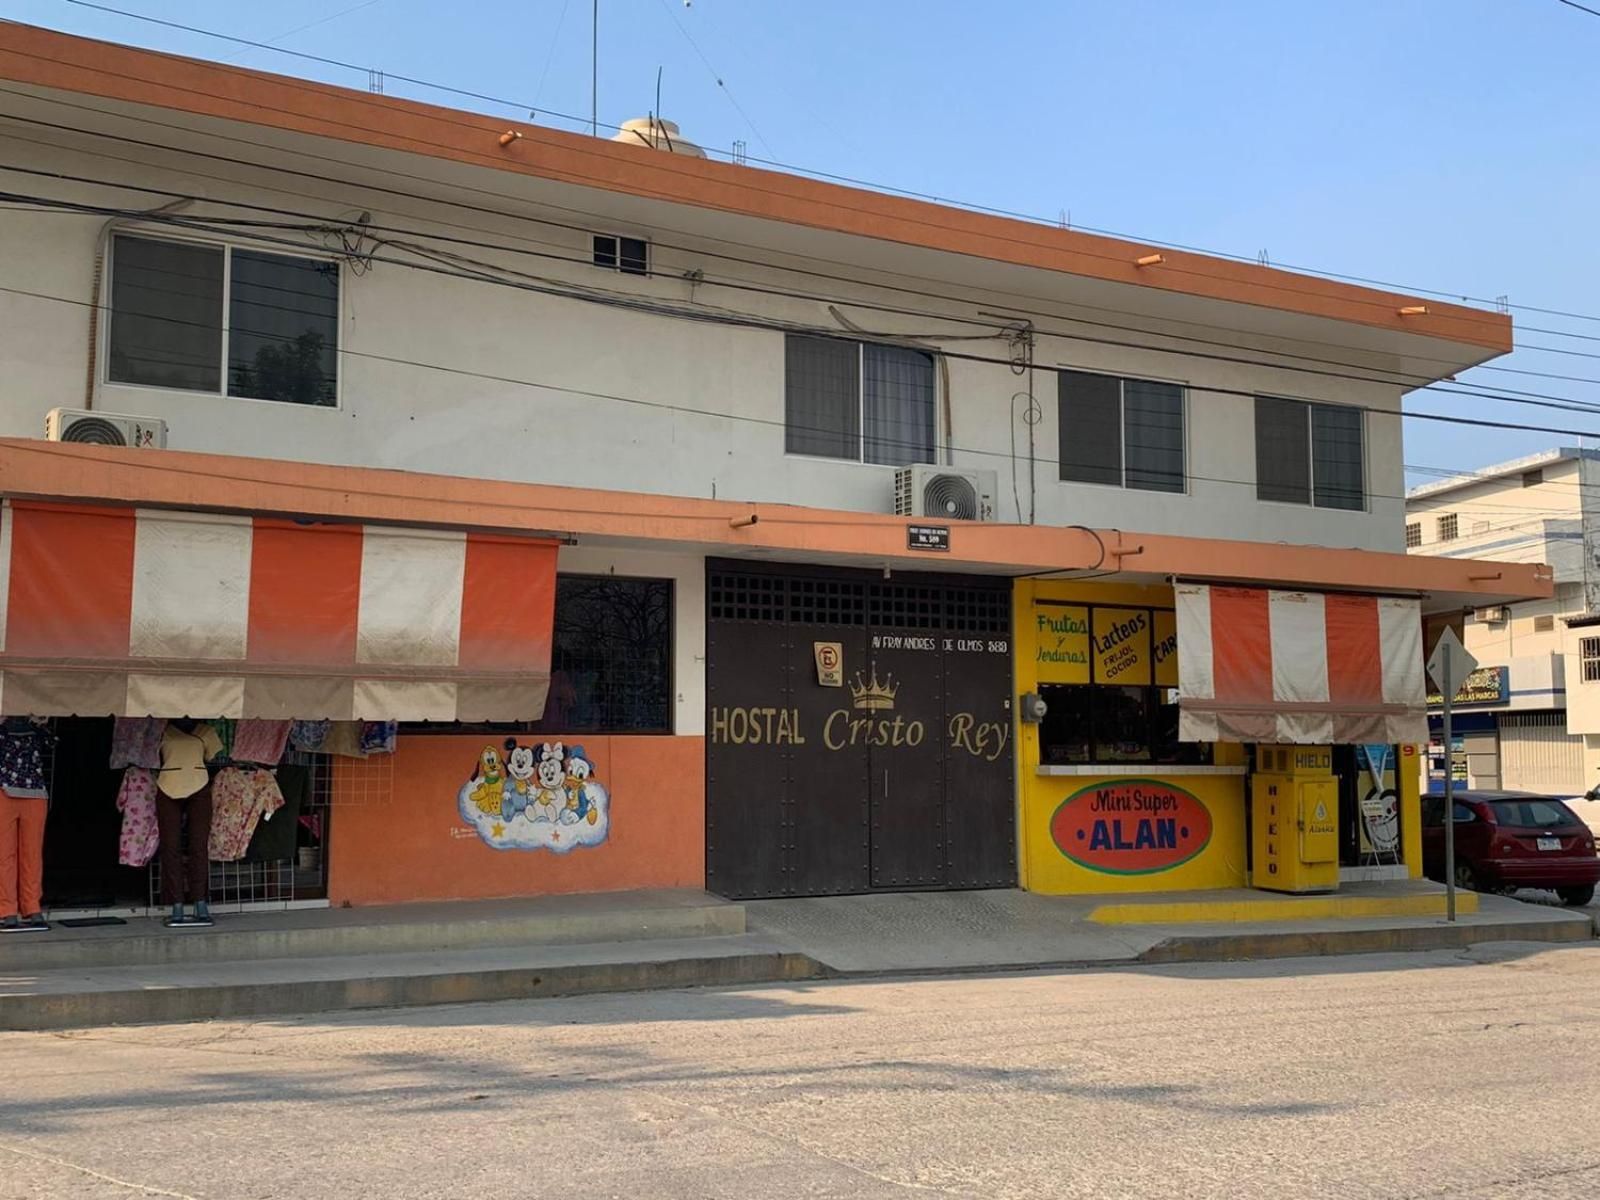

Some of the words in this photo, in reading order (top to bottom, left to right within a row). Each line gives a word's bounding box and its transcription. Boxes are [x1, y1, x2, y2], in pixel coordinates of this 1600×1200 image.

[1037, 615, 1088, 634] Frutas
[1092, 613, 1147, 655] Lacteos
[882, 636, 901, 649] FRAY
[903, 637, 935, 650] ANDRES
[942, 639, 954, 651] DE
[957, 640, 983, 652] OLMOS
[1056, 636, 1066, 648] y
[1103, 645, 1135, 668] FRIJOL
[1106, 655, 1138, 679] COCIDO
[711, 707, 806, 745] HOSTAL
[823, 708, 924, 751] Cristo
[950, 712, 1009, 761] Rey
[1295, 752, 1330, 769] HIELO
[1090, 789, 1130, 812] Mini
[1133, 789, 1179, 816] Super
[1088, 818, 1177, 851] ALAN
